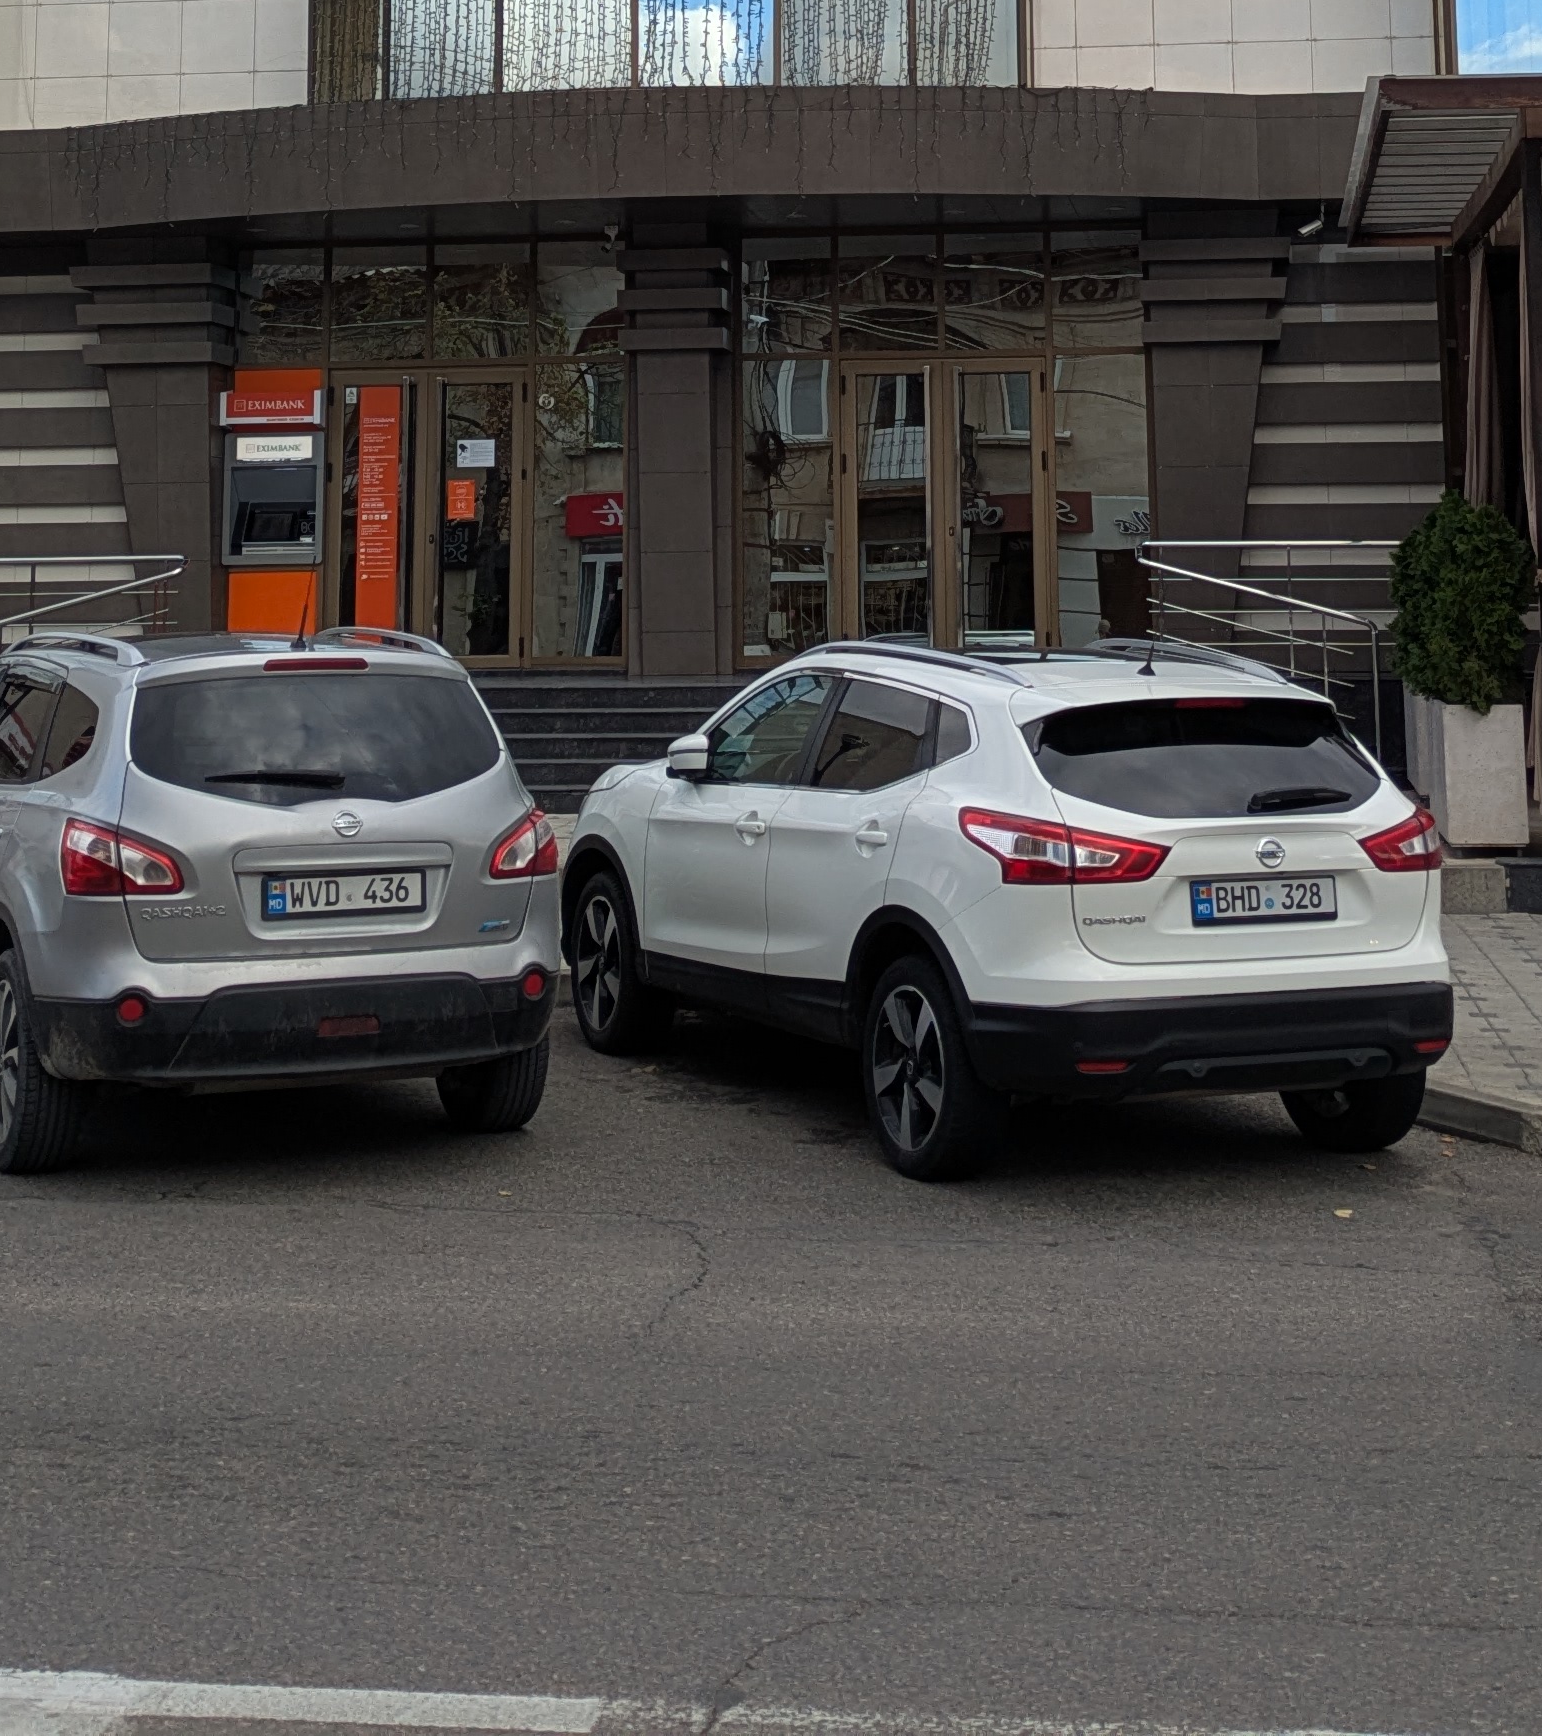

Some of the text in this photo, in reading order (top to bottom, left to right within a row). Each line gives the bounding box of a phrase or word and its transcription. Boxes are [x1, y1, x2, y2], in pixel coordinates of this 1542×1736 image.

[247, 399, 306, 410] EXIMBANK
[256, 444, 302, 453] EXIMBANK
[290, 876, 410, 909] WVD 436
[1215, 883, 1322, 914] BHD 328
[268, 898, 283, 910] MD
[1197, 902, 1210, 915] MD
[1082, 915, 1147, 927] QASHQAI
